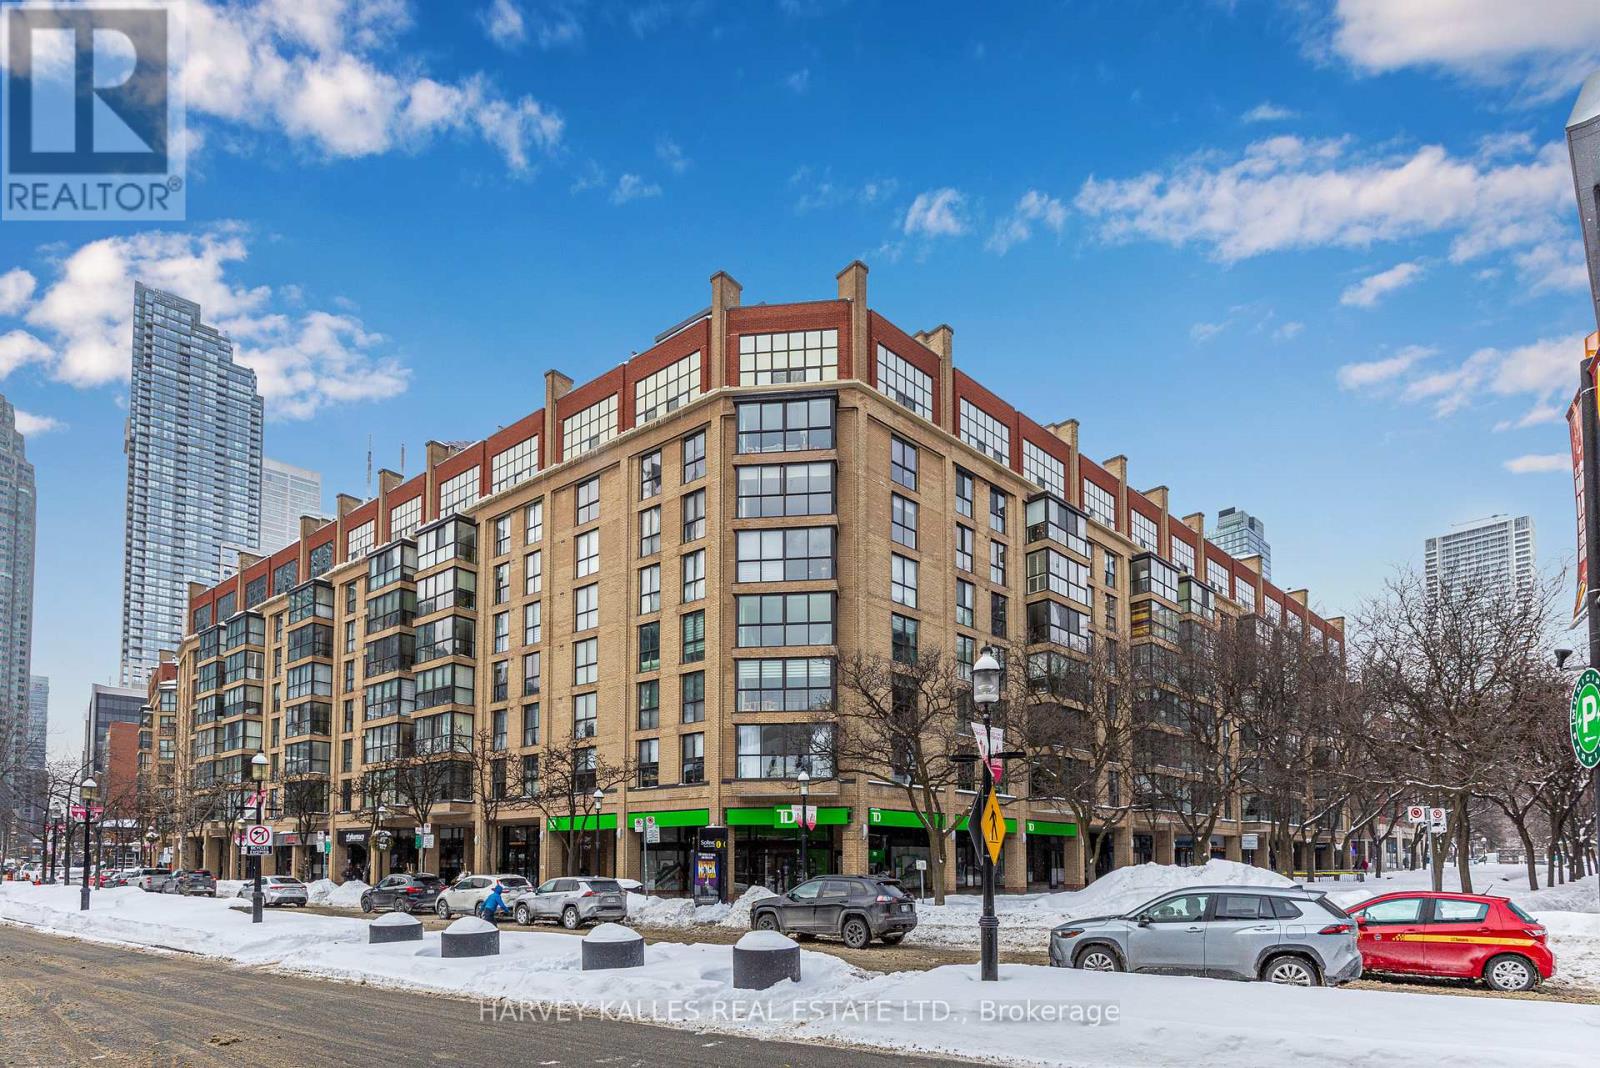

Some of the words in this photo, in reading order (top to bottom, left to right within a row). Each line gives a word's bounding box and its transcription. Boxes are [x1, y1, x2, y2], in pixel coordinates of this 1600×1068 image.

[1582, 695, 1598, 734] P
[1573, 732, 1600, 763] PARKI
[776, 809, 796, 824] TD
[872, 812, 882, 823] TD
[1027, 822, 1035, 832] TD
